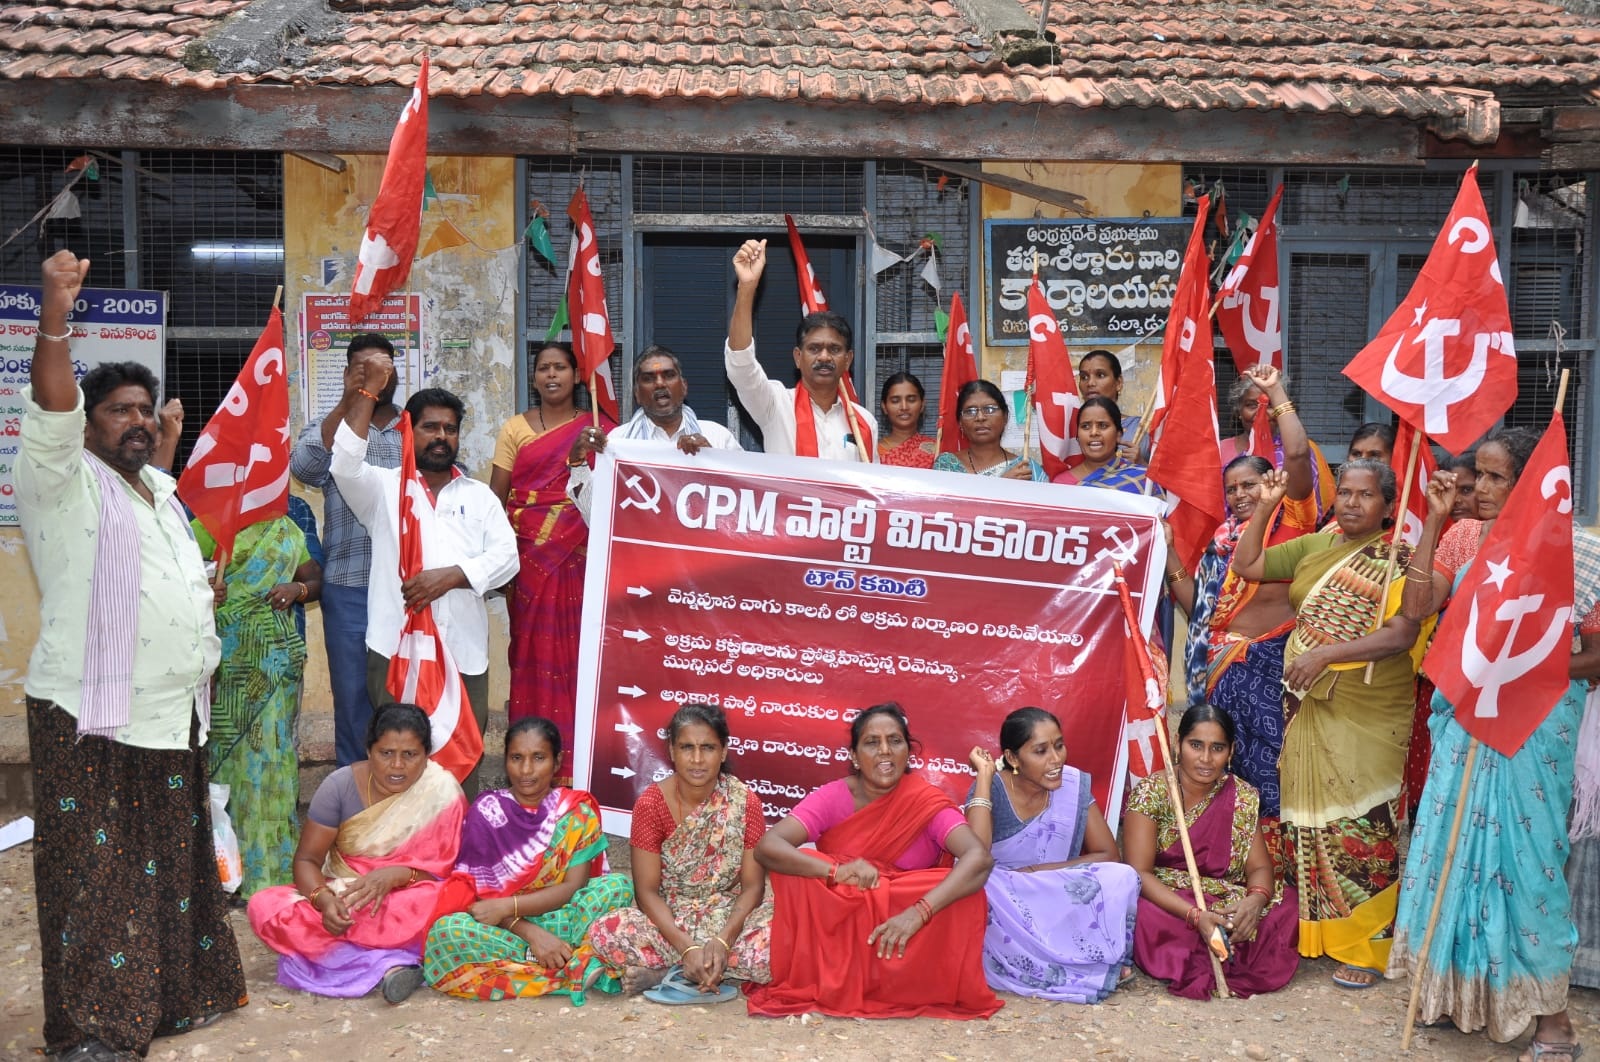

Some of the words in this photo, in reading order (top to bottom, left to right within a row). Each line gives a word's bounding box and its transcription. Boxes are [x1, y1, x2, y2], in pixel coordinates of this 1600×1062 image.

[1138, 249, 1180, 270] వారి
[103, 299, 157, 314] 2005
[1000, 275, 1177, 316] కార్యాలయమ
[100, 328, 157, 340] వినుకొండ
[676, 482, 780, 537] CPM
[786, 496, 877, 564] పార్టీ
[887, 512, 1090, 566] వినుకొండ
[667, 588, 736, 610] వెన్నపూస
[740, 598, 782, 613] వాగు
[785, 602, 831, 620] కాలనీ
[835, 605, 857, 621] లో
[860, 610, 908, 630] అక్రమ
[912, 616, 979, 639] నిర్మాణం
[982, 622, 1084, 647] నిలిపివేయాలి
[664, 634, 712, 651] అక్రమ
[715, 638, 798, 659] కట్టడాలను
[663, 655, 735, 676] మున్సిపల్
[736, 663, 824, 684] అధికారులు
[660, 689, 720, 706] అధికార
[723, 696, 757, 716] పార్టీ
[760, 700, 839, 721] నాయకుల
[762, 740, 831, 765] దారులపై
[927, 758, 978, 776] నమో
